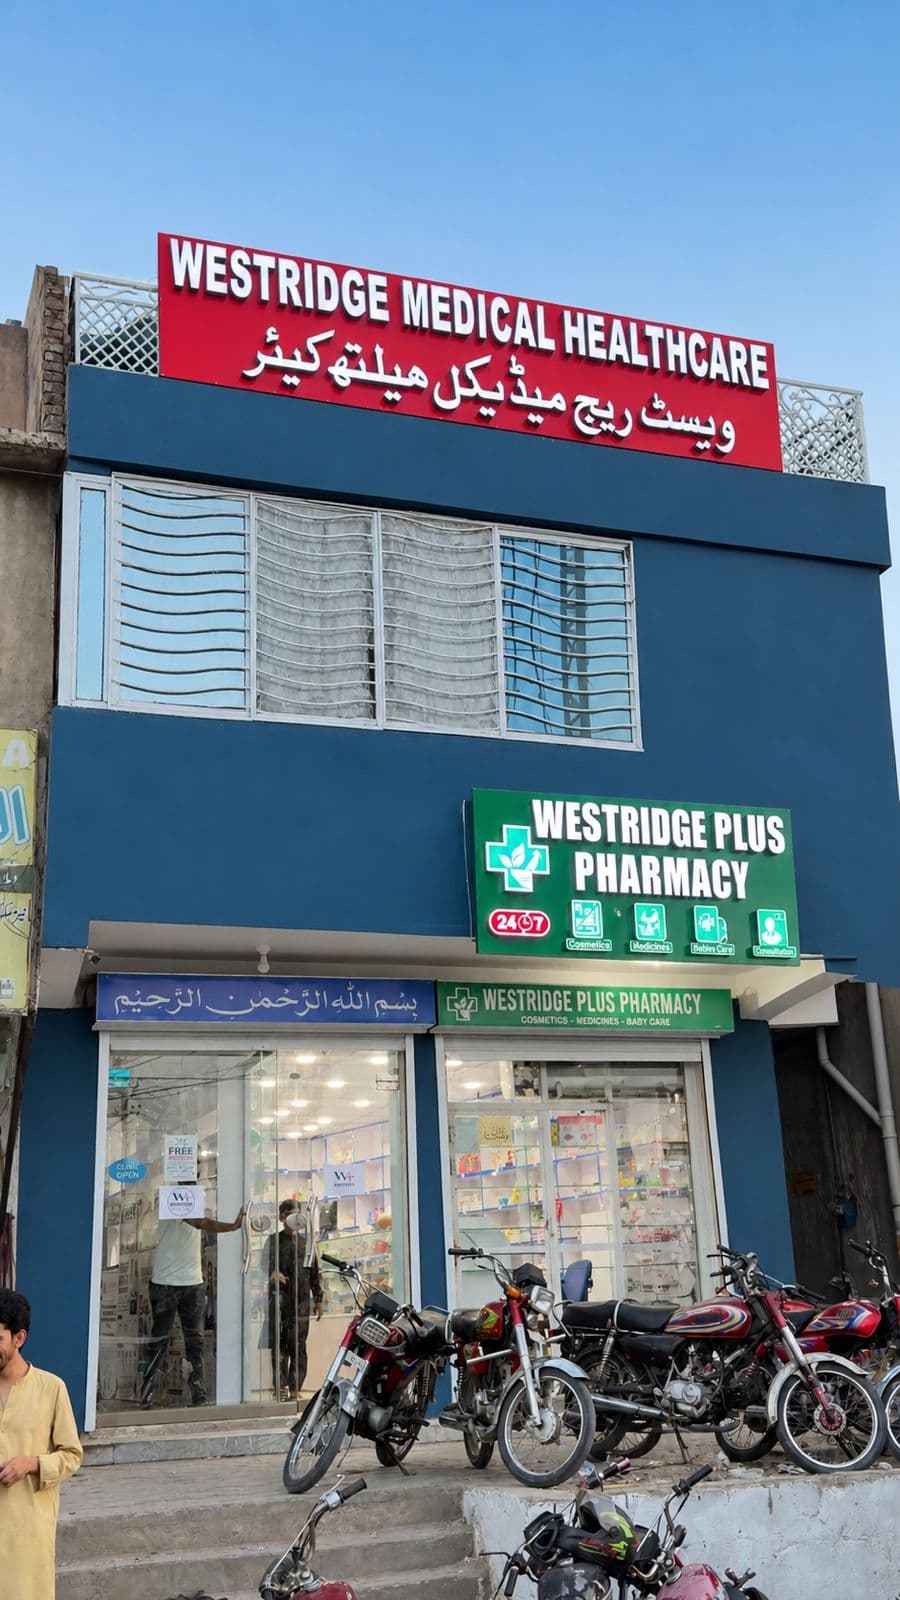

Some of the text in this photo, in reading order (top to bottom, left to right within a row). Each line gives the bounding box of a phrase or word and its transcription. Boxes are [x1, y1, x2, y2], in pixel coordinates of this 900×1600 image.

[170, 238, 769, 390] WESTRIDGE MEDICAL HEALTHCARE
[532, 798, 786, 854] WESTRIDGE PLUS
[574, 851, 749, 900] PHARMACY
[568, 940, 610, 950] Cosmetics
[632, 941, 670, 951] Medicines
[717, 944, 733, 954] Care
[482, 988, 702, 1015] WESTRIDGE PLUS PHARMACY
[520, 1015, 568, 1025] COSMETICS
[576, 1016, 619, 1026] MEDICINES
[626, 1017, 648, 1027] BABY
[649, 1017, 671, 1027] CARE
[168, 1146, 193, 1155] FREE
[116, 1171, 140, 1179] OPEN
